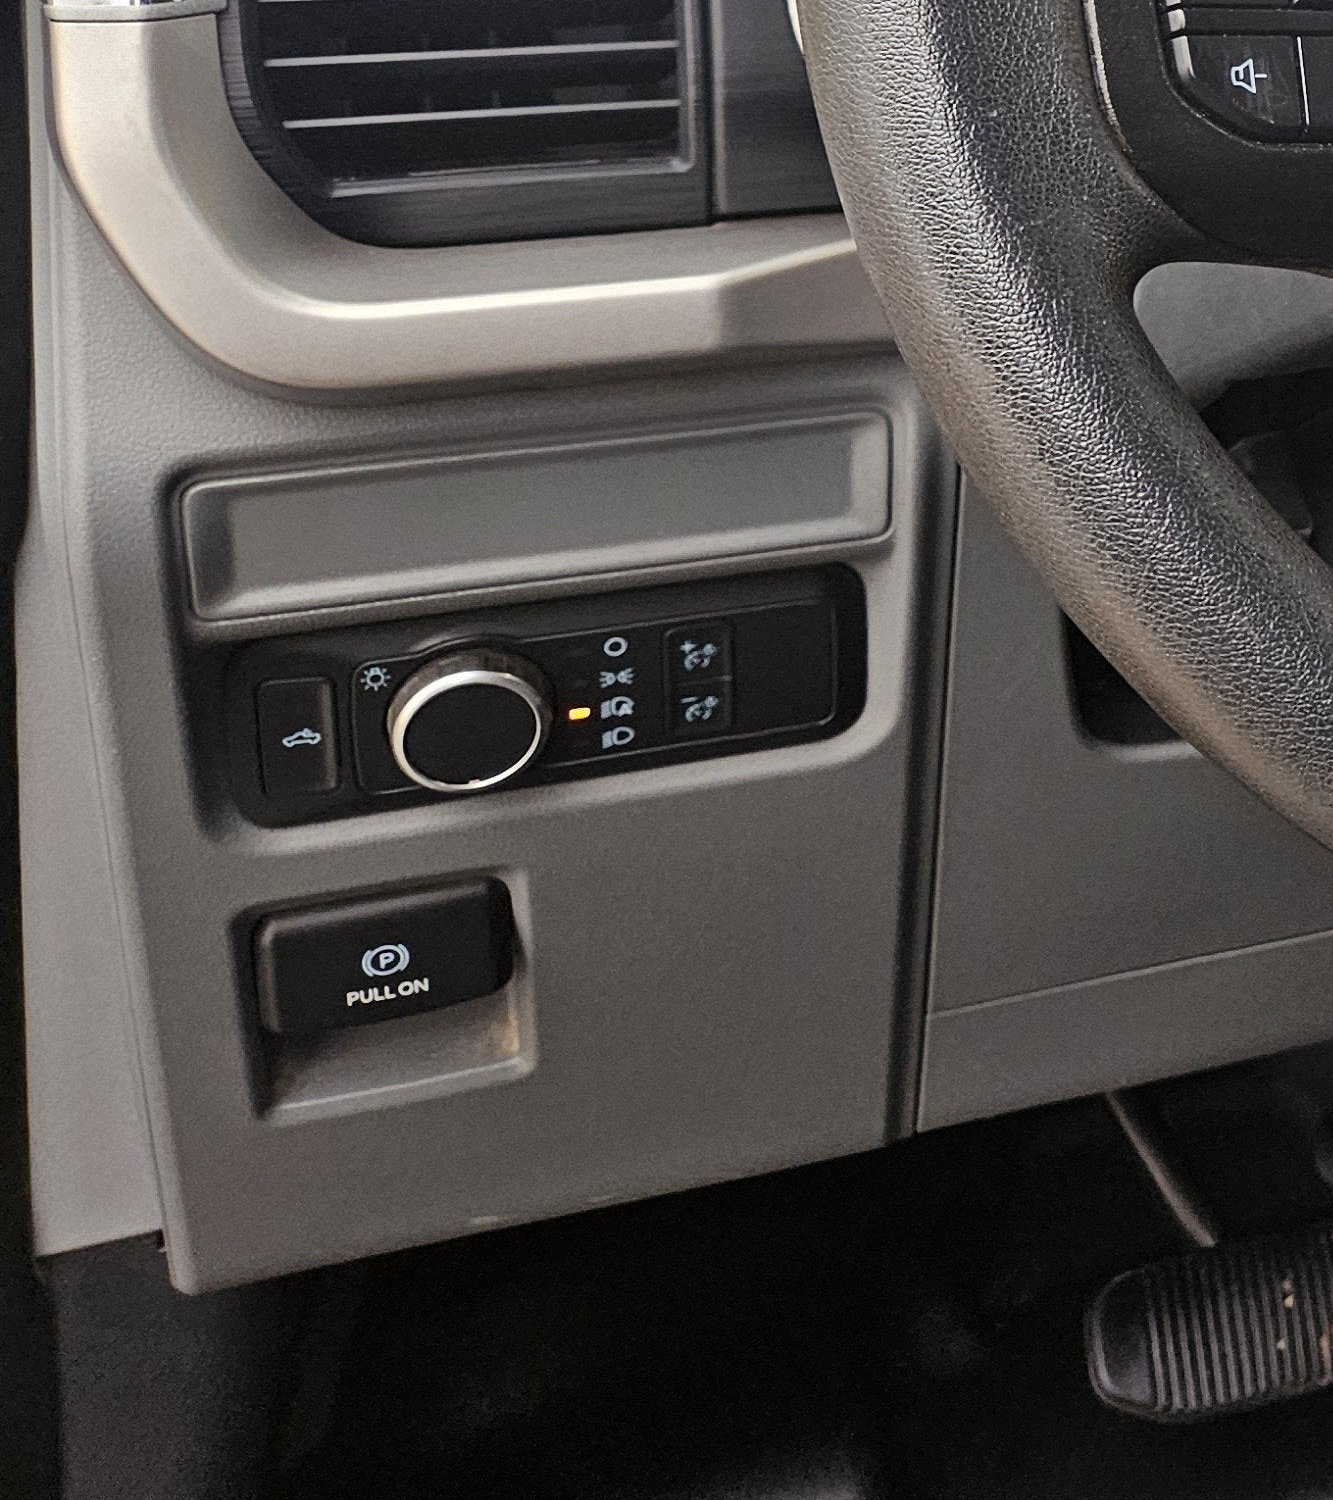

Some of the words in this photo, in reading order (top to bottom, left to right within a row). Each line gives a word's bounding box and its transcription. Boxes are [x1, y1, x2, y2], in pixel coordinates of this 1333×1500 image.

[379, 952, 395, 970] P
[346, 985, 397, 1007] PULL
[397, 977, 430, 997] ON
